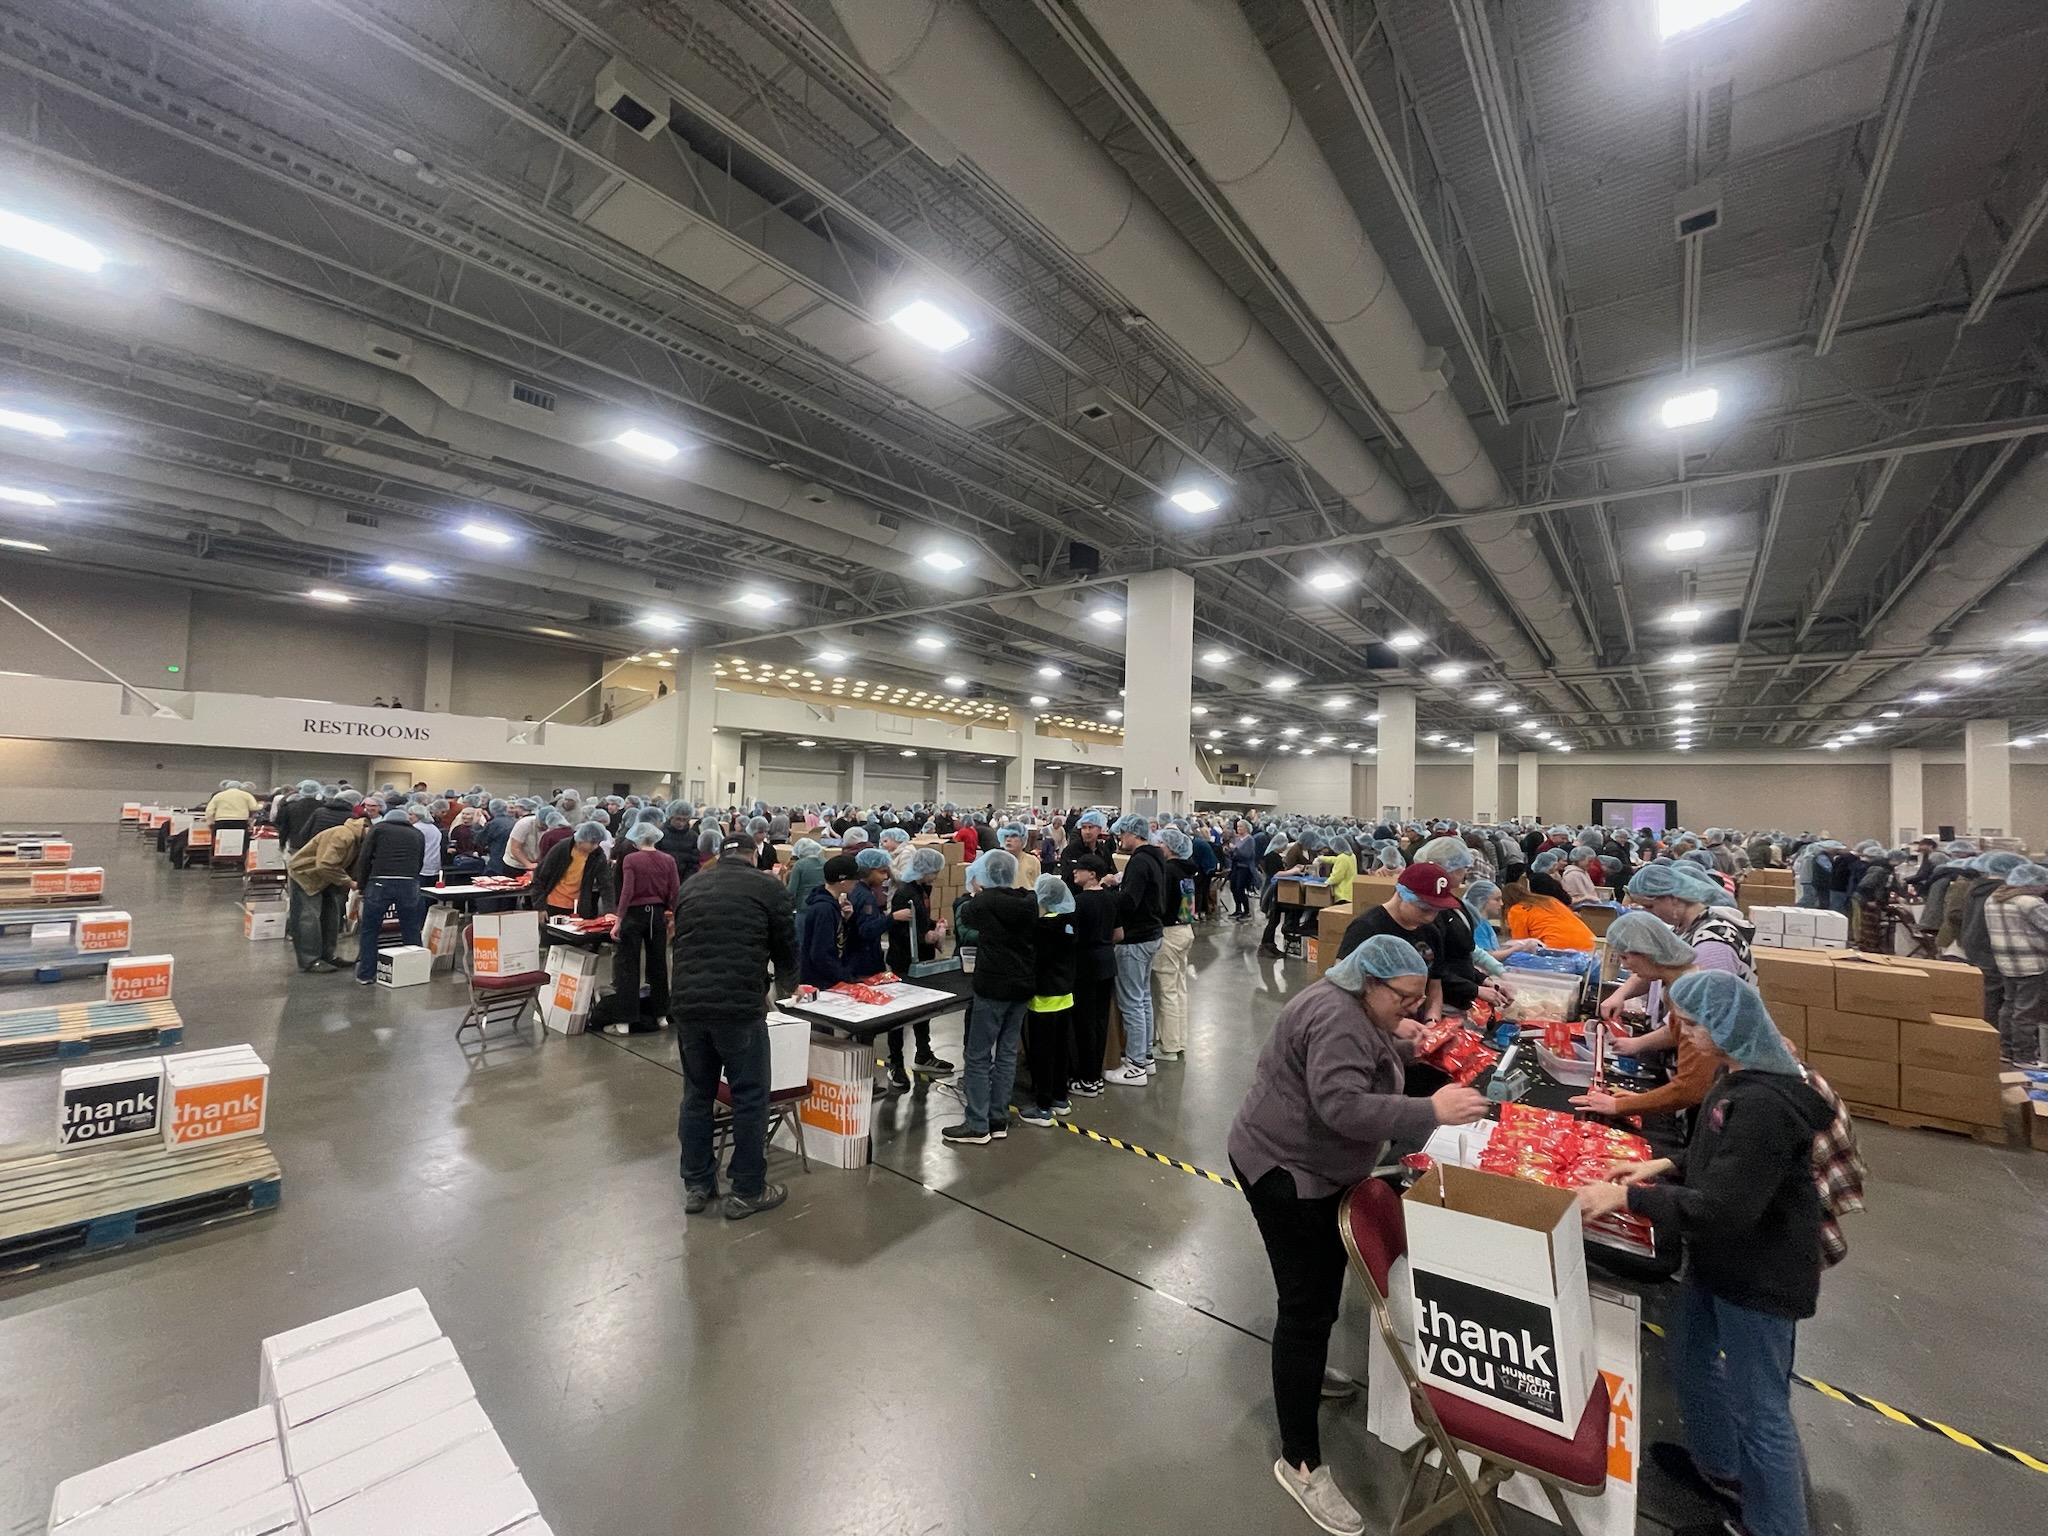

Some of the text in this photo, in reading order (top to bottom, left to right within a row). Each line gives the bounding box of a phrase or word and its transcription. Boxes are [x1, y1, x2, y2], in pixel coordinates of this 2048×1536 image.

[303, 718, 430, 741] RESTROOMS
[1436, 876, 1449, 895] P
[473, 947, 498, 960] thank
[63, 1092, 155, 1125] thank
[174, 1093, 260, 1125] thank
[60, 1119, 116, 1144] you
[171, 1119, 223, 1143] you
[1414, 1296, 1555, 1378] thank
[1417, 1337, 1497, 1391] you
[1500, 1364, 1551, 1390] HUNGER
[1517, 1379, 1556, 1402] FIGHT
